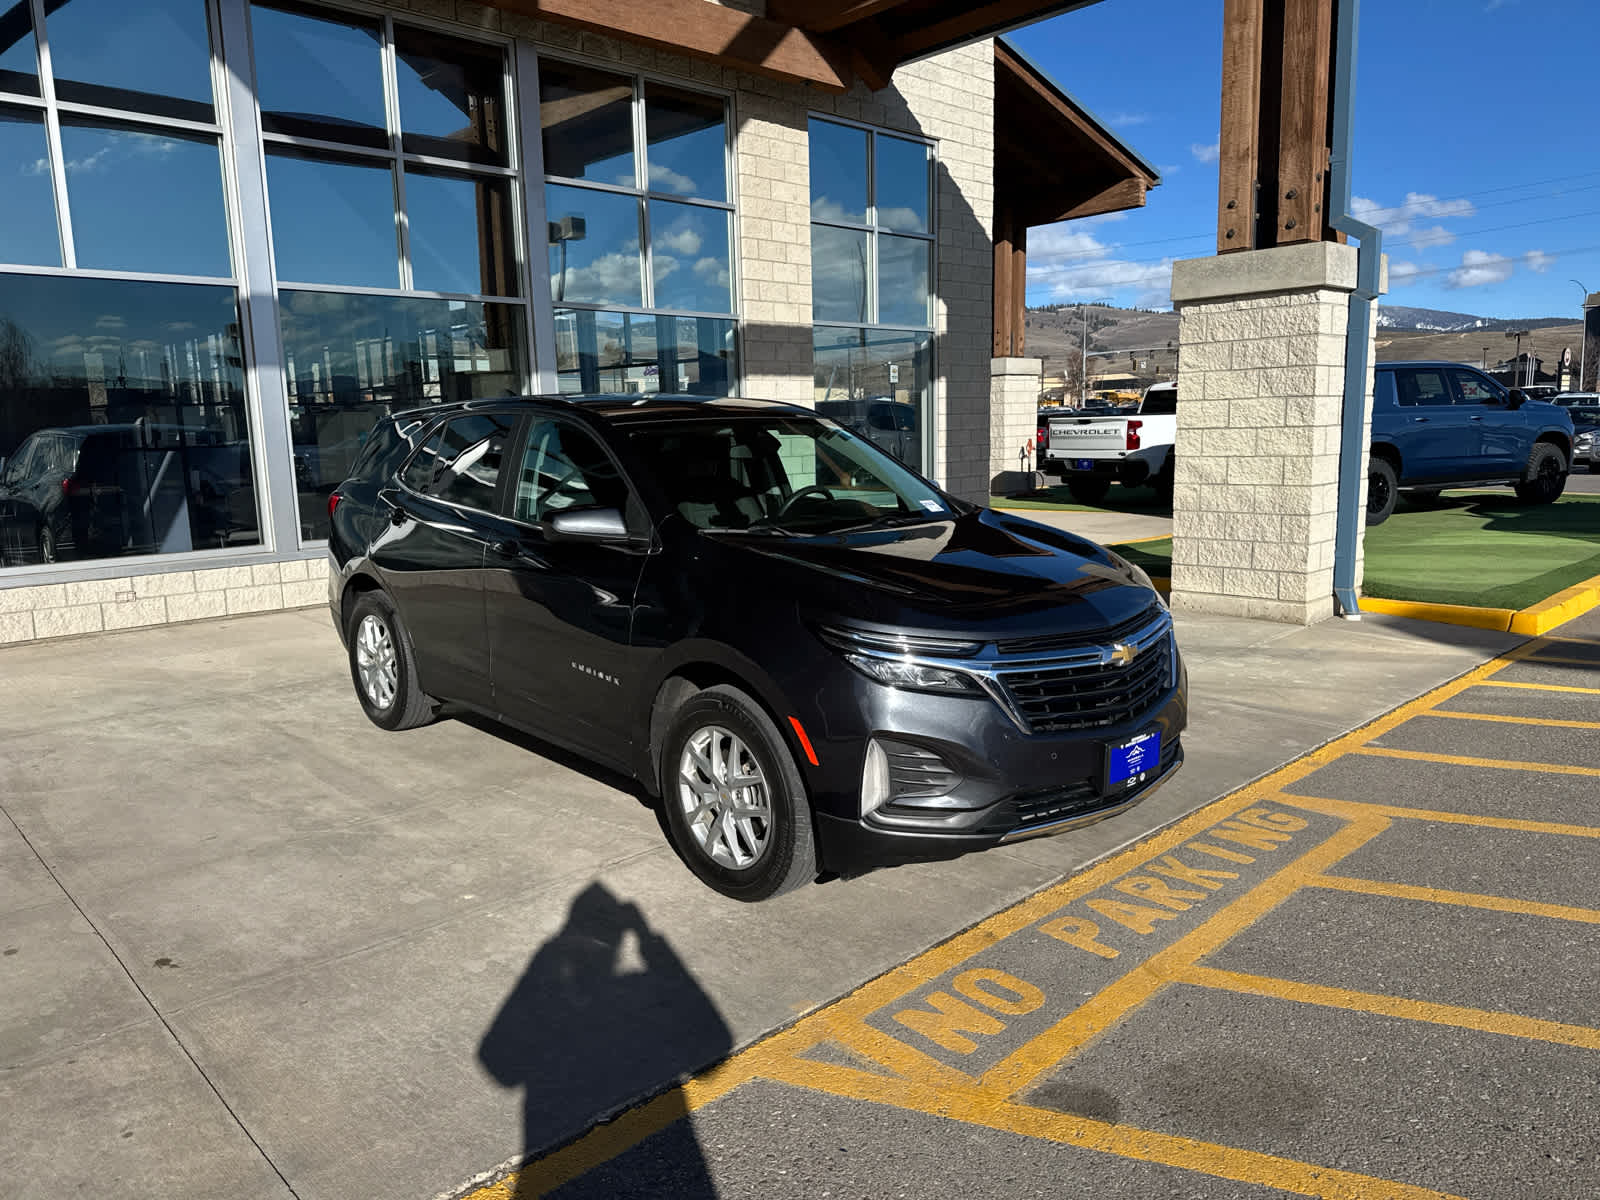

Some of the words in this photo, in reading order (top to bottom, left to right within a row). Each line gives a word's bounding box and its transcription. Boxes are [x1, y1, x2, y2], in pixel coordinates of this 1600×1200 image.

[1052, 428, 1120, 436] CHEVROLET
[892, 967, 1047, 1057] NO
[1037, 807, 1310, 960] PARKING
